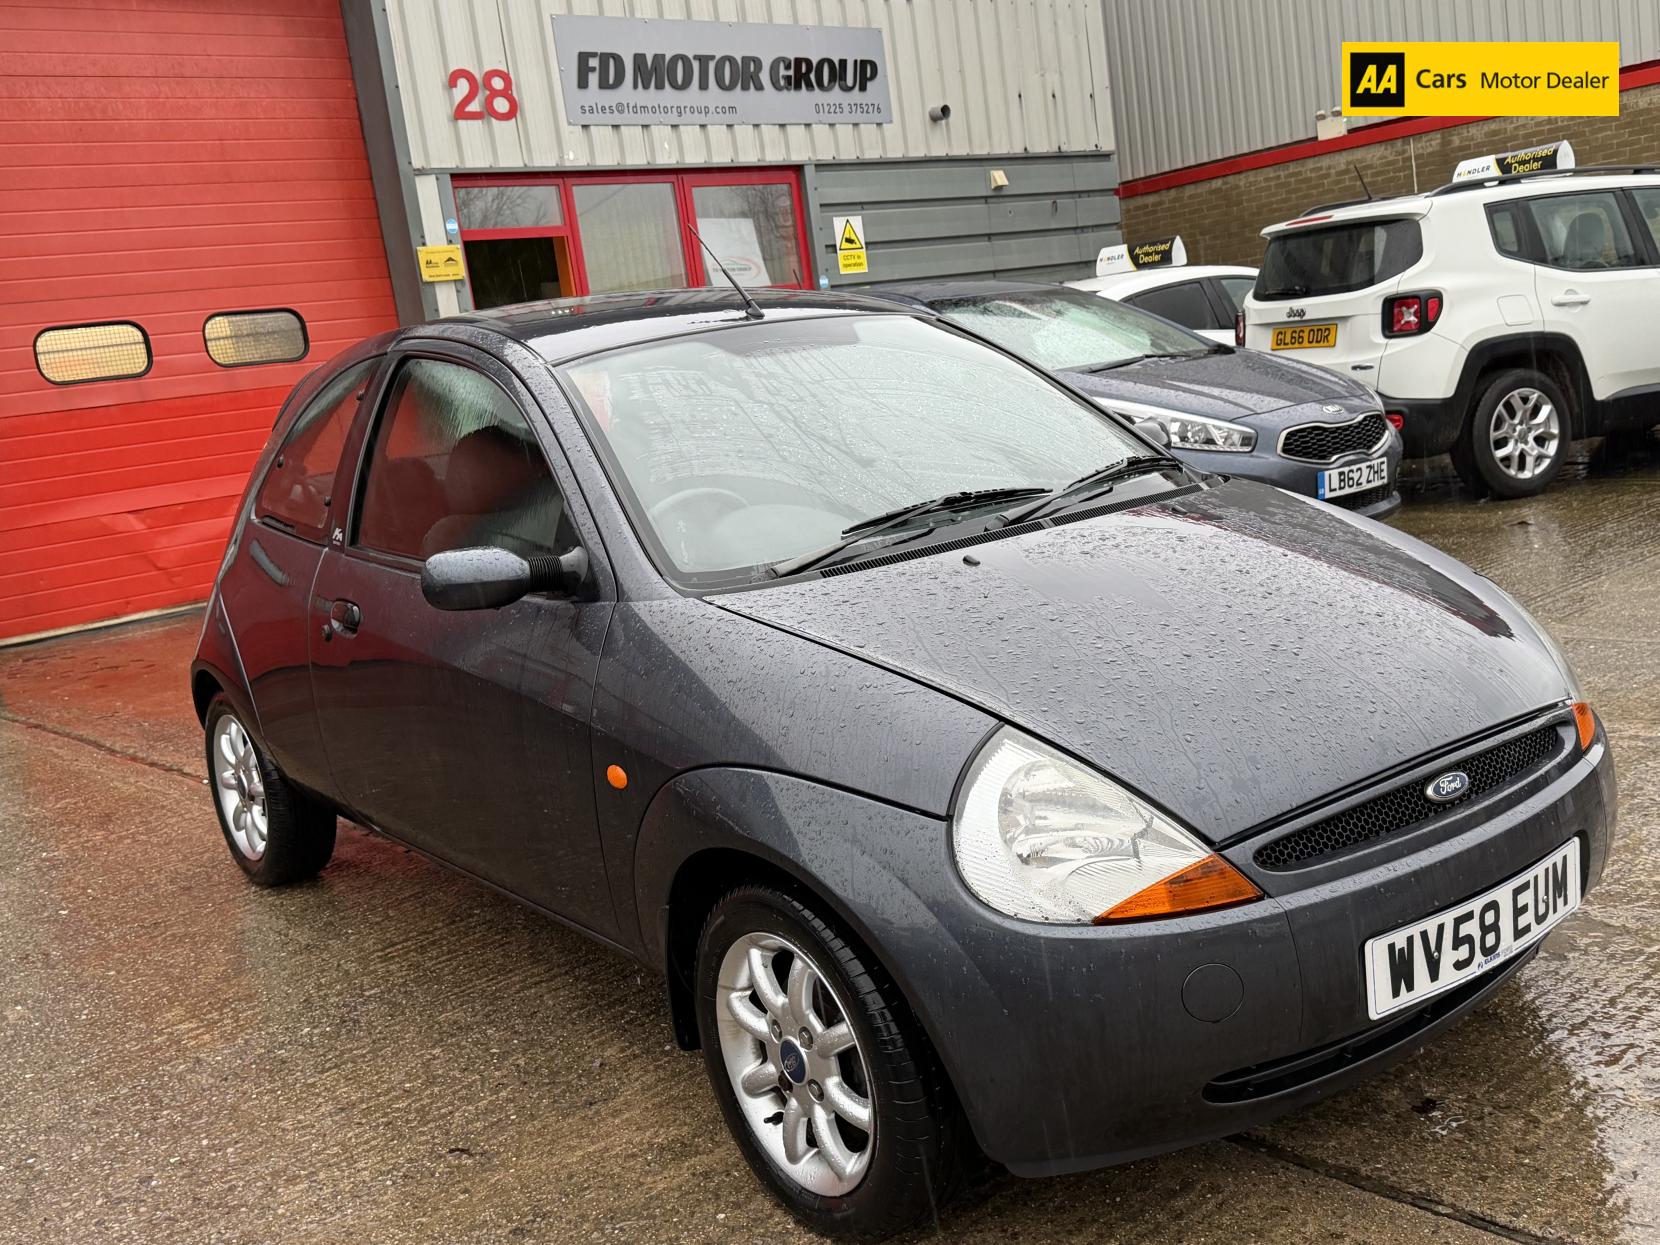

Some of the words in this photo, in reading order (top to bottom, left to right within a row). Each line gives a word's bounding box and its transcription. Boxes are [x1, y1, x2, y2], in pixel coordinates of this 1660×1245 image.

[577, 51, 626, 90] FD
[633, 53, 765, 92] MOTOR
[769, 57, 878, 93] GROUP
[448, 68, 519, 121] 28
[580, 102, 738, 117] sales@fdmotorgroup.com
[814, 103, 844, 114] 01225
[847, 103, 882, 114] 375276
[1504, 145, 1556, 165] Authorised
[1511, 160, 1543, 175] Dealer
[1134, 240, 1171, 255] Authorised
[1139, 253, 1162, 264] Dealer
[1275, 329, 1305, 346] GL66
[1307, 327, 1331, 344] ODR
[1328, 467, 1363, 493] LB62
[1365, 460, 1386, 485] ZHE
[1439, 775, 1462, 795] Ford
[1387, 899, 1501, 1000] WV58
[1512, 853, 1568, 943] EUM
